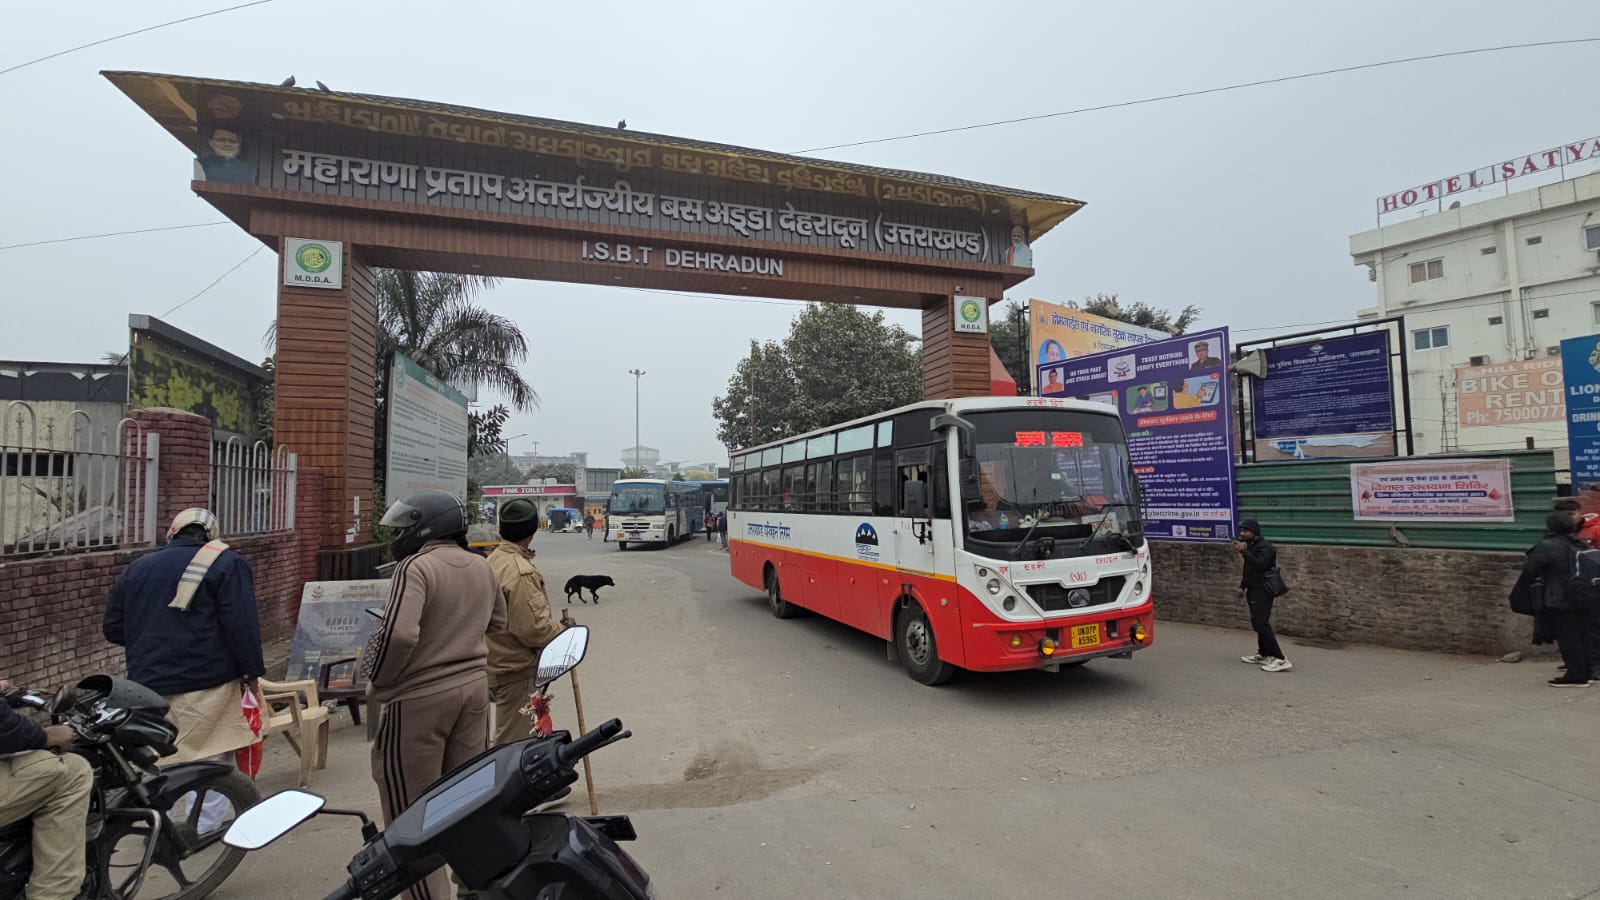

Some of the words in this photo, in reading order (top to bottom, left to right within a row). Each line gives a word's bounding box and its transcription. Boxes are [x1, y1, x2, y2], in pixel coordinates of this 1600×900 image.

[1383, 170, 1484, 213] HOTEL
[281, 149, 419, 190] महाराणा
[424, 166, 505, 198] प्रताप
[506, 174, 655, 216] अंतर्राज्यीय
[660, 195, 704, 222] बस
[705, 200, 774, 236] अड्डा
[778, 202, 869, 248] देहरादून
[874, 213, 989, 263] (उत्तराखण्ड)
[582, 240, 652, 265] I.S.B.T
[665, 248, 784, 276] DEHRADUN
[294, 274, 332, 284] M.D.D.A.
[1141, 355, 1158, 364] TRUST
[1461, 373, 1530, 394] BIKE
[1485, 388, 1565, 409] RENT
[1466, 411, 1489, 424] Ph:
